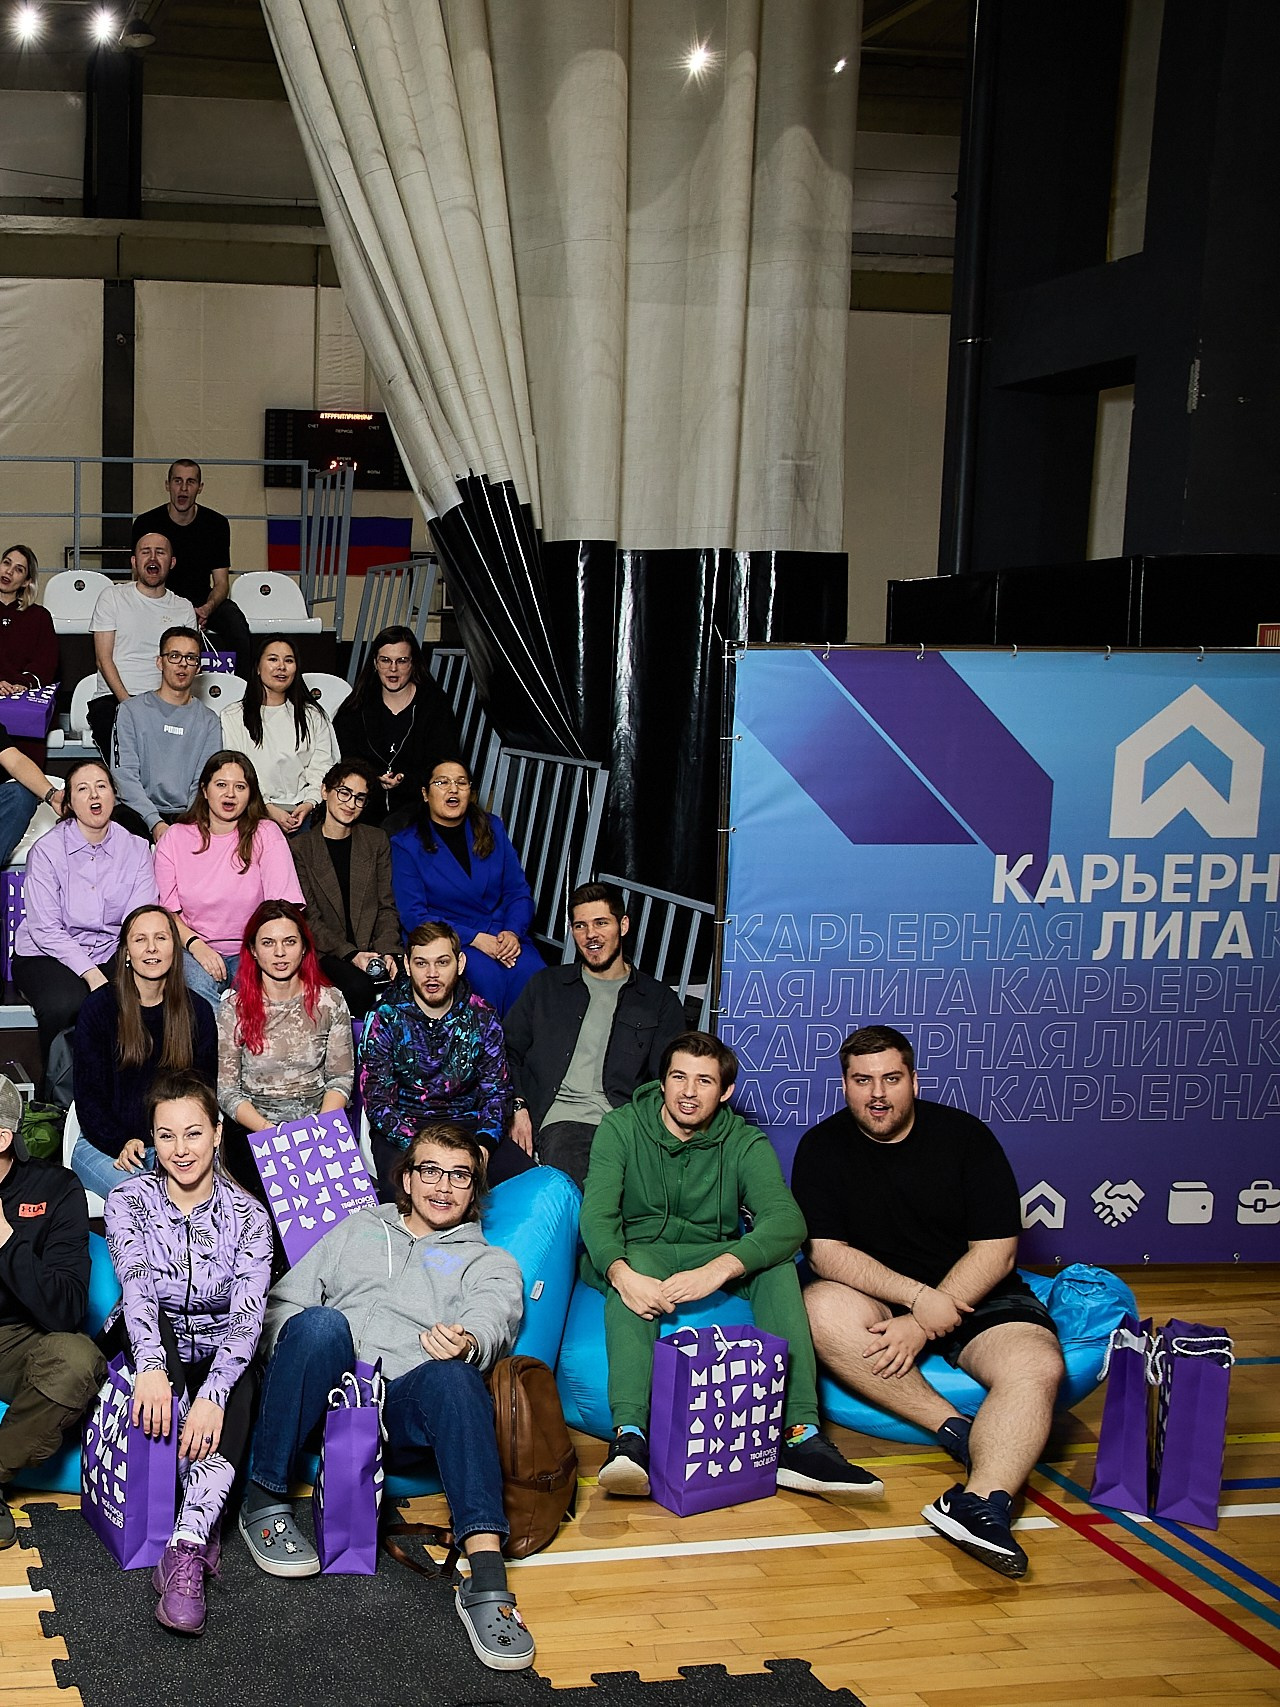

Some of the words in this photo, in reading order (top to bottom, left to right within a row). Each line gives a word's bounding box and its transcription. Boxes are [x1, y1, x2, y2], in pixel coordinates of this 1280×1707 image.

[163, 724, 184, 736] PUMA
[992, 853, 1280, 904] КАРЬЕРН
[723, 912, 1084, 963] КАРЬЕРНАЯ
[1091, 910, 1254, 961] ЛИГА
[821, 967, 977, 1017] ЛИГА
[722, 1022, 1077, 1072] КАРРНАЯ
[1084, 1019, 1238, 1068] ЛИГА
